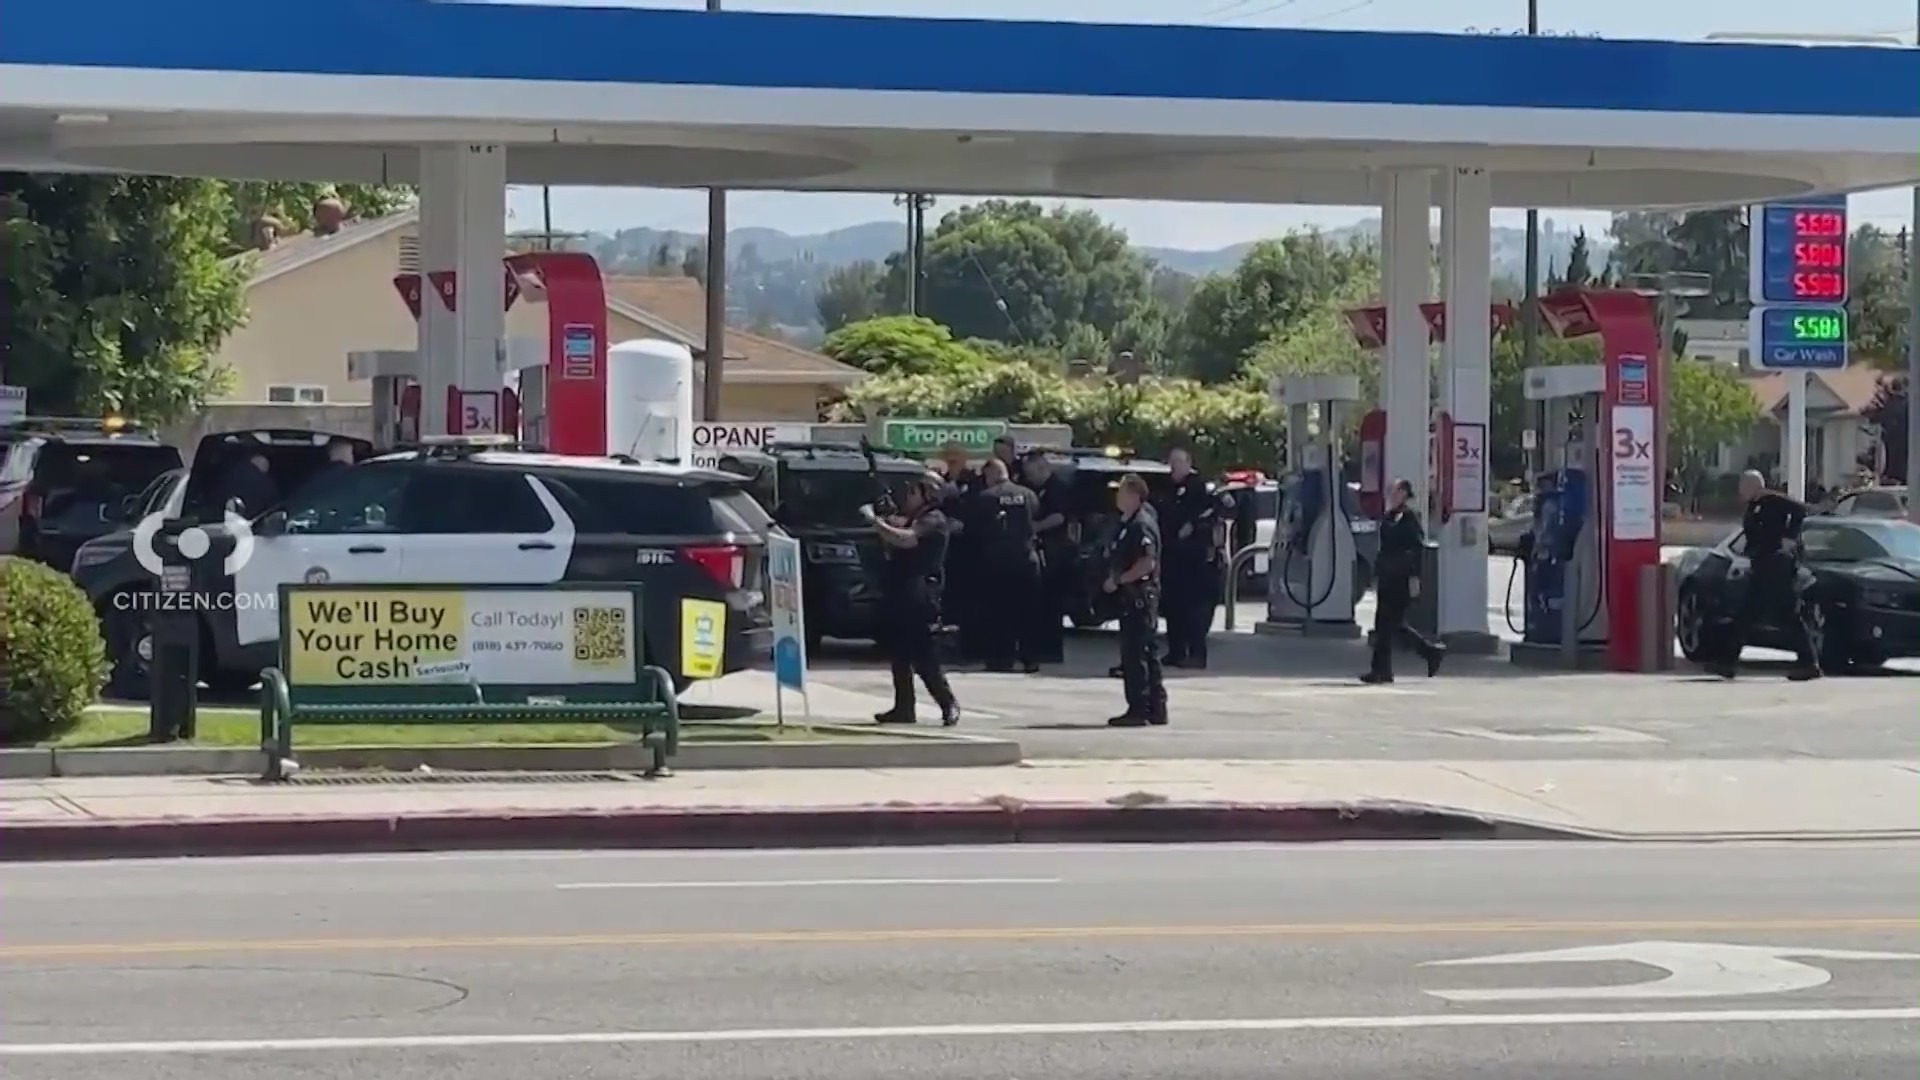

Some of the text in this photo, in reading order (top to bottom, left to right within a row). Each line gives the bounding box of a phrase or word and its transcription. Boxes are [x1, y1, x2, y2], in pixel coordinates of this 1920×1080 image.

[1774, 348, 1838, 361] Car Wash
[465, 406, 492, 430] 3x
[904, 426, 989, 446] Propane
[1615, 427, 1650, 459] 3x
[1455, 437, 1480, 460] 3x
[307, 600, 445, 630] We'll Buy
[471, 611, 564, 629] Call Today!
[297, 628, 458, 651] Your Home
